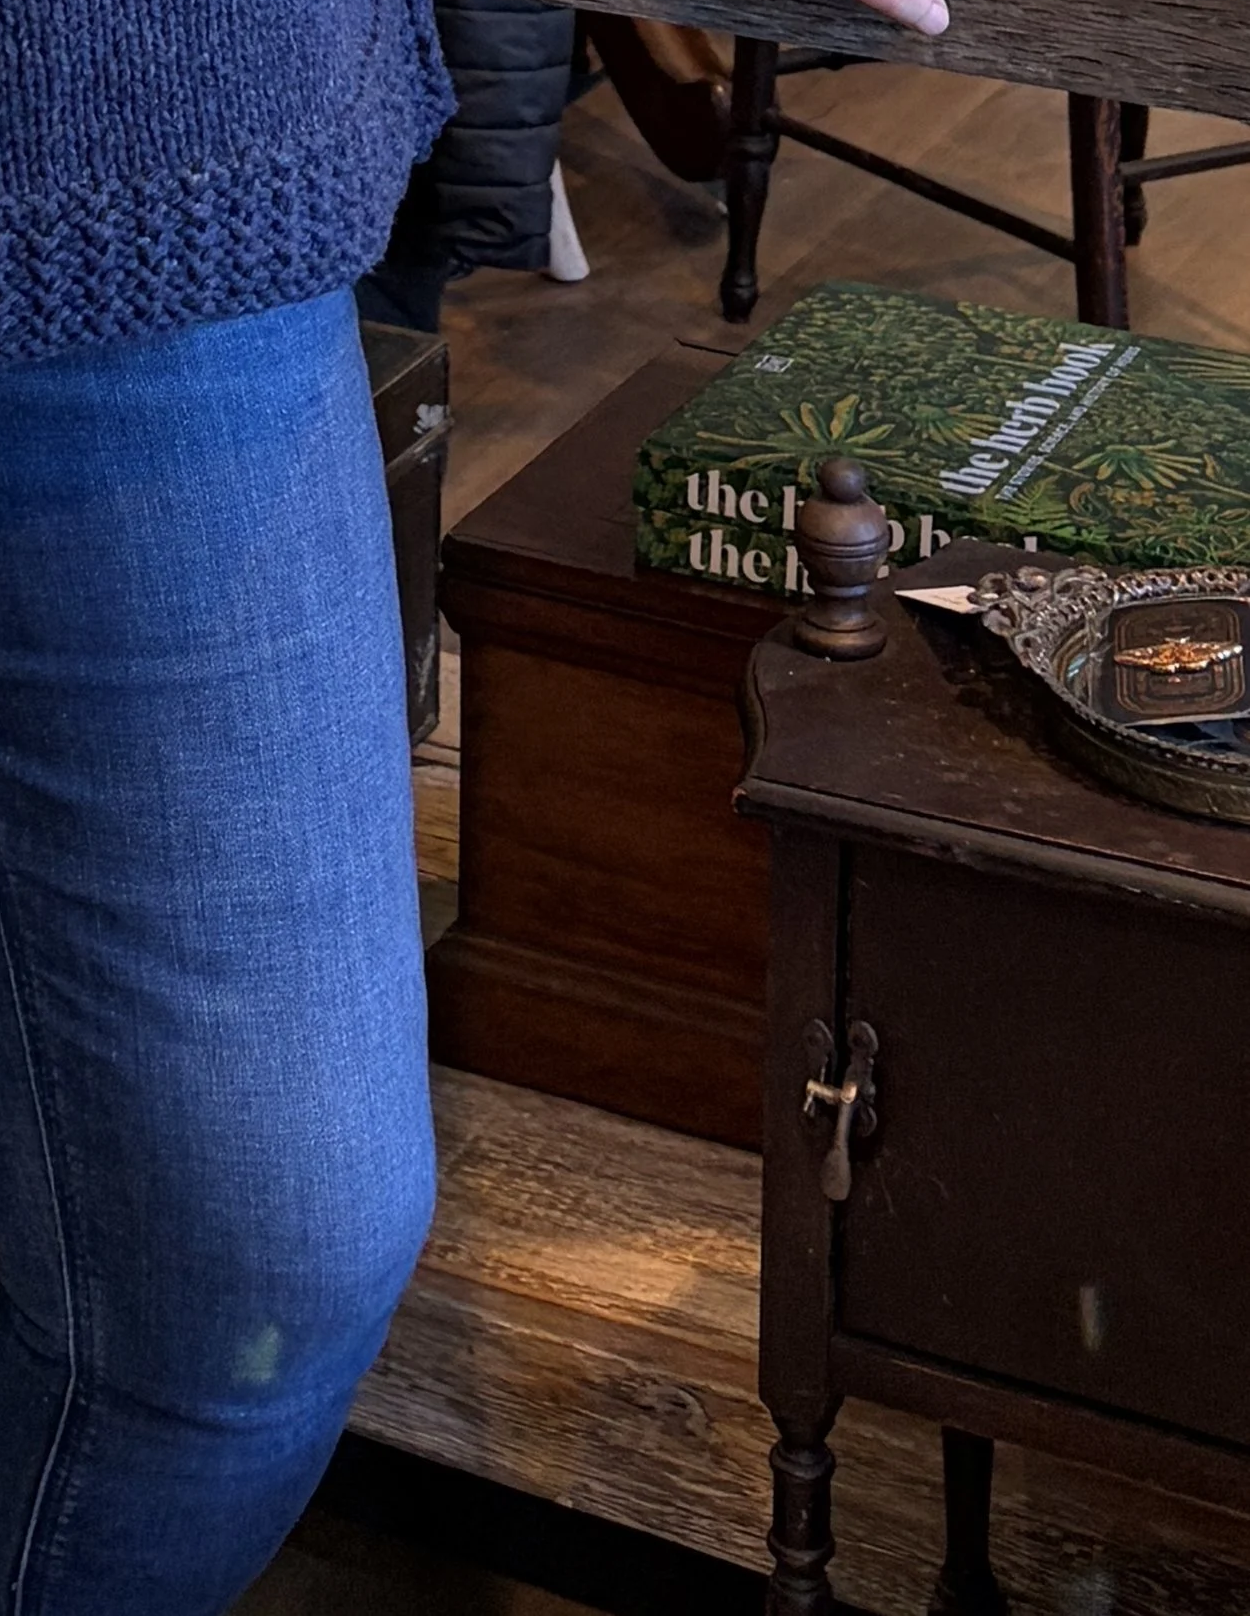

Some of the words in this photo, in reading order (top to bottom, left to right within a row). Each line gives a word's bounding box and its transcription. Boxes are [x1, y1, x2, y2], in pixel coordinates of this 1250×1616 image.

[1023, 342, 1116, 396] book
[970, 396, 1061, 454] herb
[686, 470, 768, 524] the
[939, 452, 1010, 495] the
[689, 529, 772, 584] the
